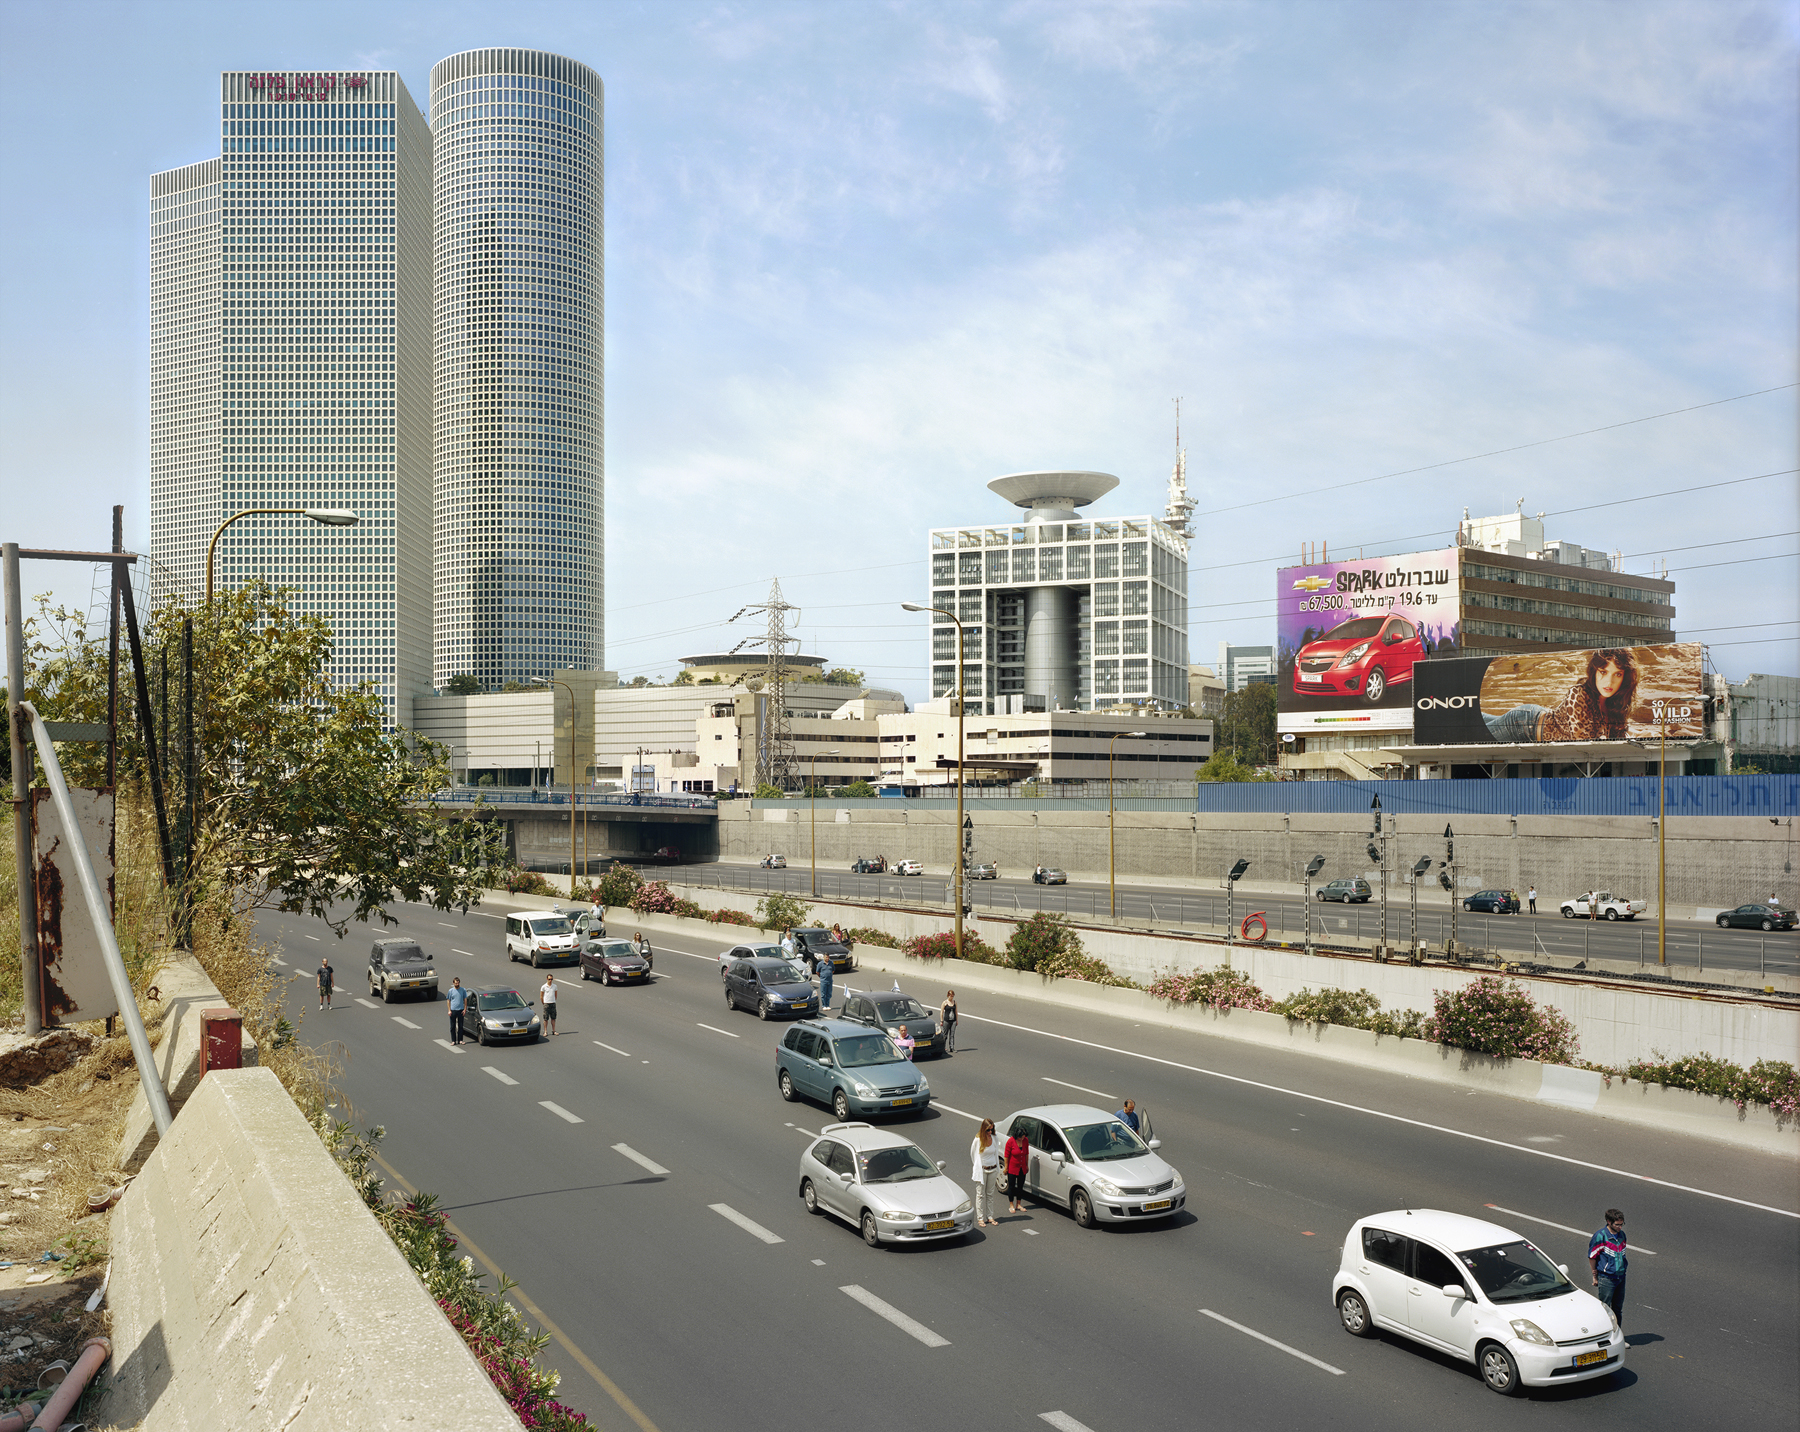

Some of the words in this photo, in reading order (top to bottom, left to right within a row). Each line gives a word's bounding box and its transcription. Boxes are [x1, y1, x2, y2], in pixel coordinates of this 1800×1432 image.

[249, 73, 286, 88] פלזה
[295, 76, 336, 92] קראון
[268, 92, 296, 101] סנטר
[300, 92, 326, 101] סיטי
[1336, 569, 1384, 593] SPARK
[1385, 567, 1449, 588] שברולט
[1309, 594, 1344, 612] 67,500
[1399, 591, 1423, 606] 19.6
[1425, 593, 1438, 605] עד
[1651, 699, 1664, 708] SO
[1651, 706, 1692, 719] WILD
